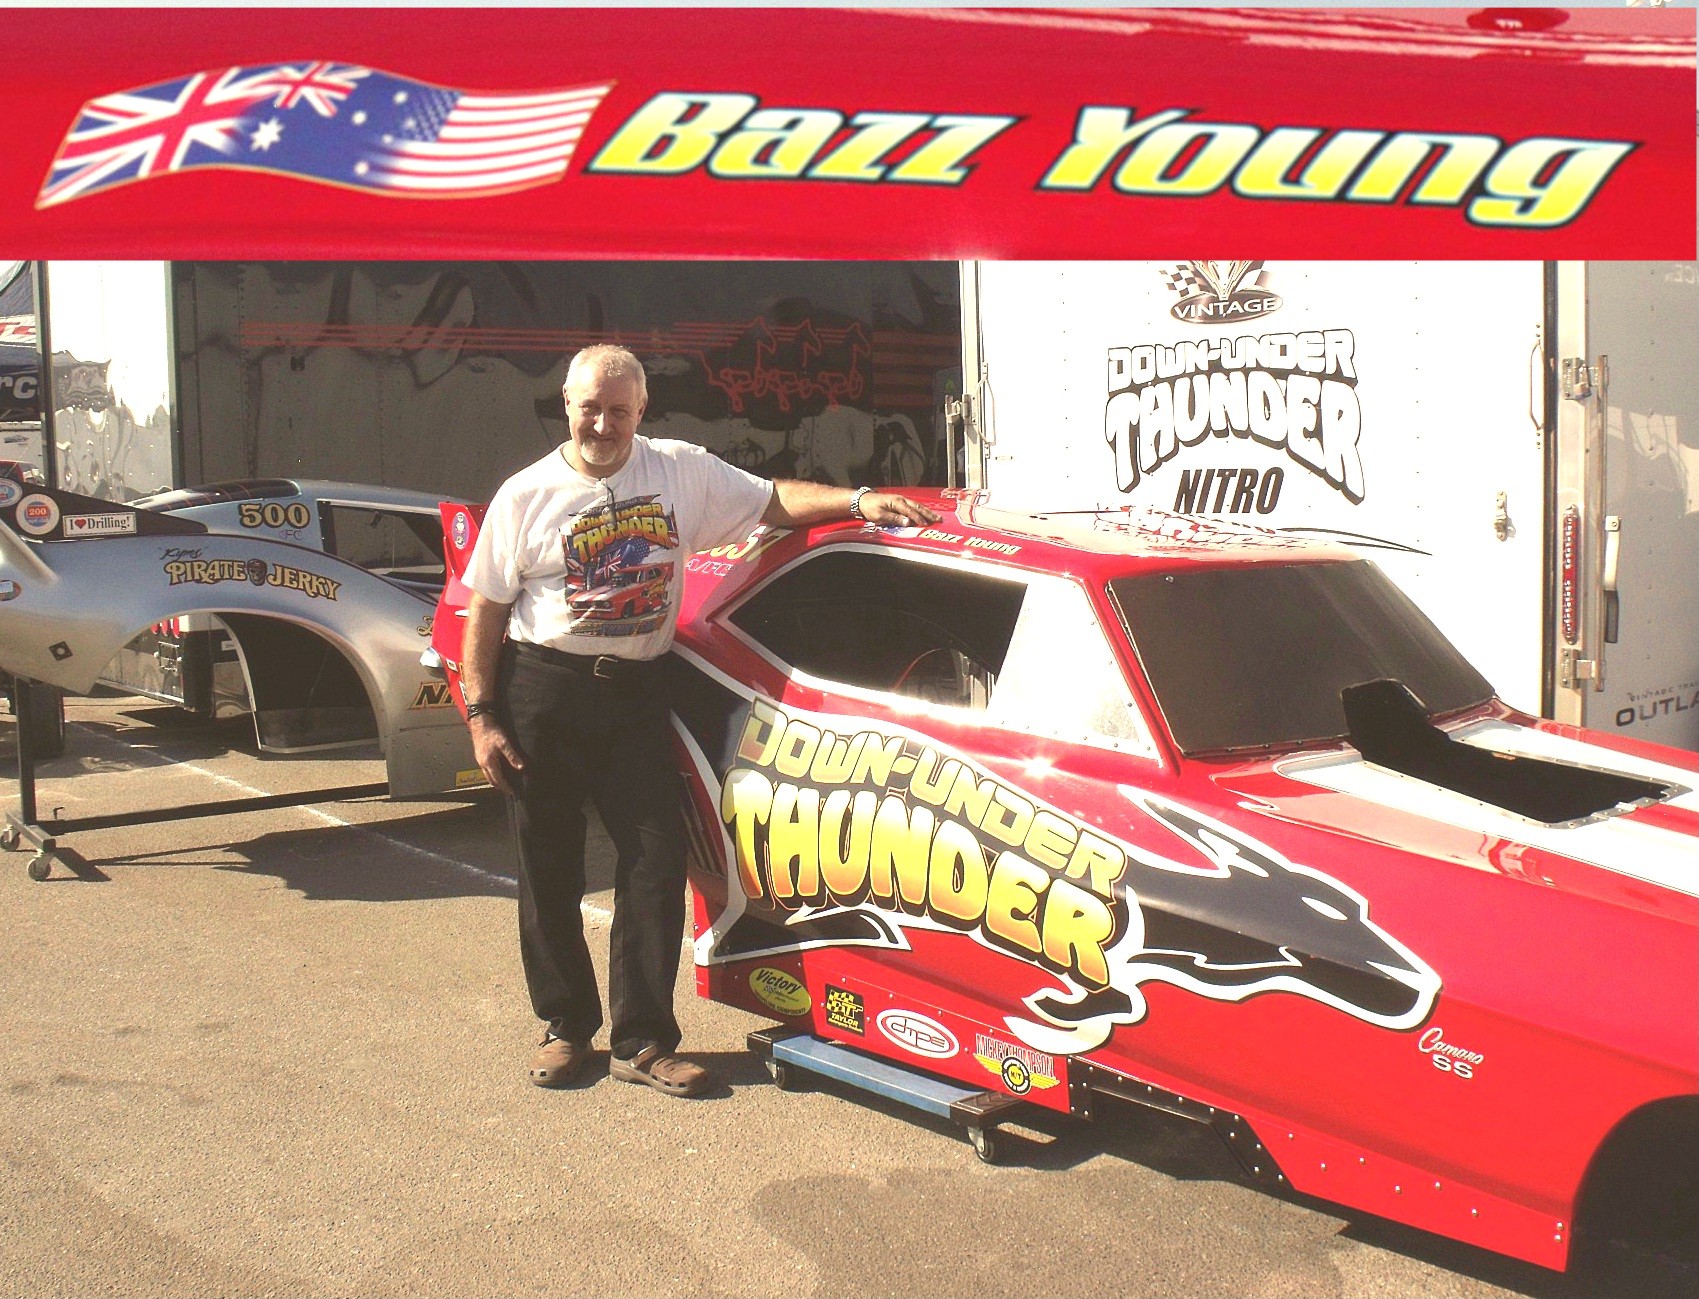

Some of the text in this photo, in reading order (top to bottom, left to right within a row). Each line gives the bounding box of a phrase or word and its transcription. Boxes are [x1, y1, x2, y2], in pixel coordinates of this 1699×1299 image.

[580, 91, 1642, 229] Bazz Young
[1174, 297, 1277, 318] VINTAGE
[1108, 329, 1358, 393] DOWN-UNDER
[1105, 371, 1365, 505] THUNDER
[1173, 467, 1284, 514] NITRO
[28, 508, 47, 516] 200
[88, 516, 130, 531] Drilling!
[238, 503, 310, 528] 500
[573, 517, 675, 563] THUNDER
[919, 530, 1022, 555] Bazz Young
[164, 559, 342, 601] PIRATE JERKY
[737, 697, 1127, 900] DOWN-UNDER
[721, 768, 1115, 993] THUNDER
[756, 969, 801, 994] Victory
[831, 1012, 859, 1027] TAYLOR
[975, 1033, 1055, 1077] MICKEY THOMPSON
[1419, 1027, 1484, 1064] Camaro
[1432, 1053, 1473, 1079] SS
